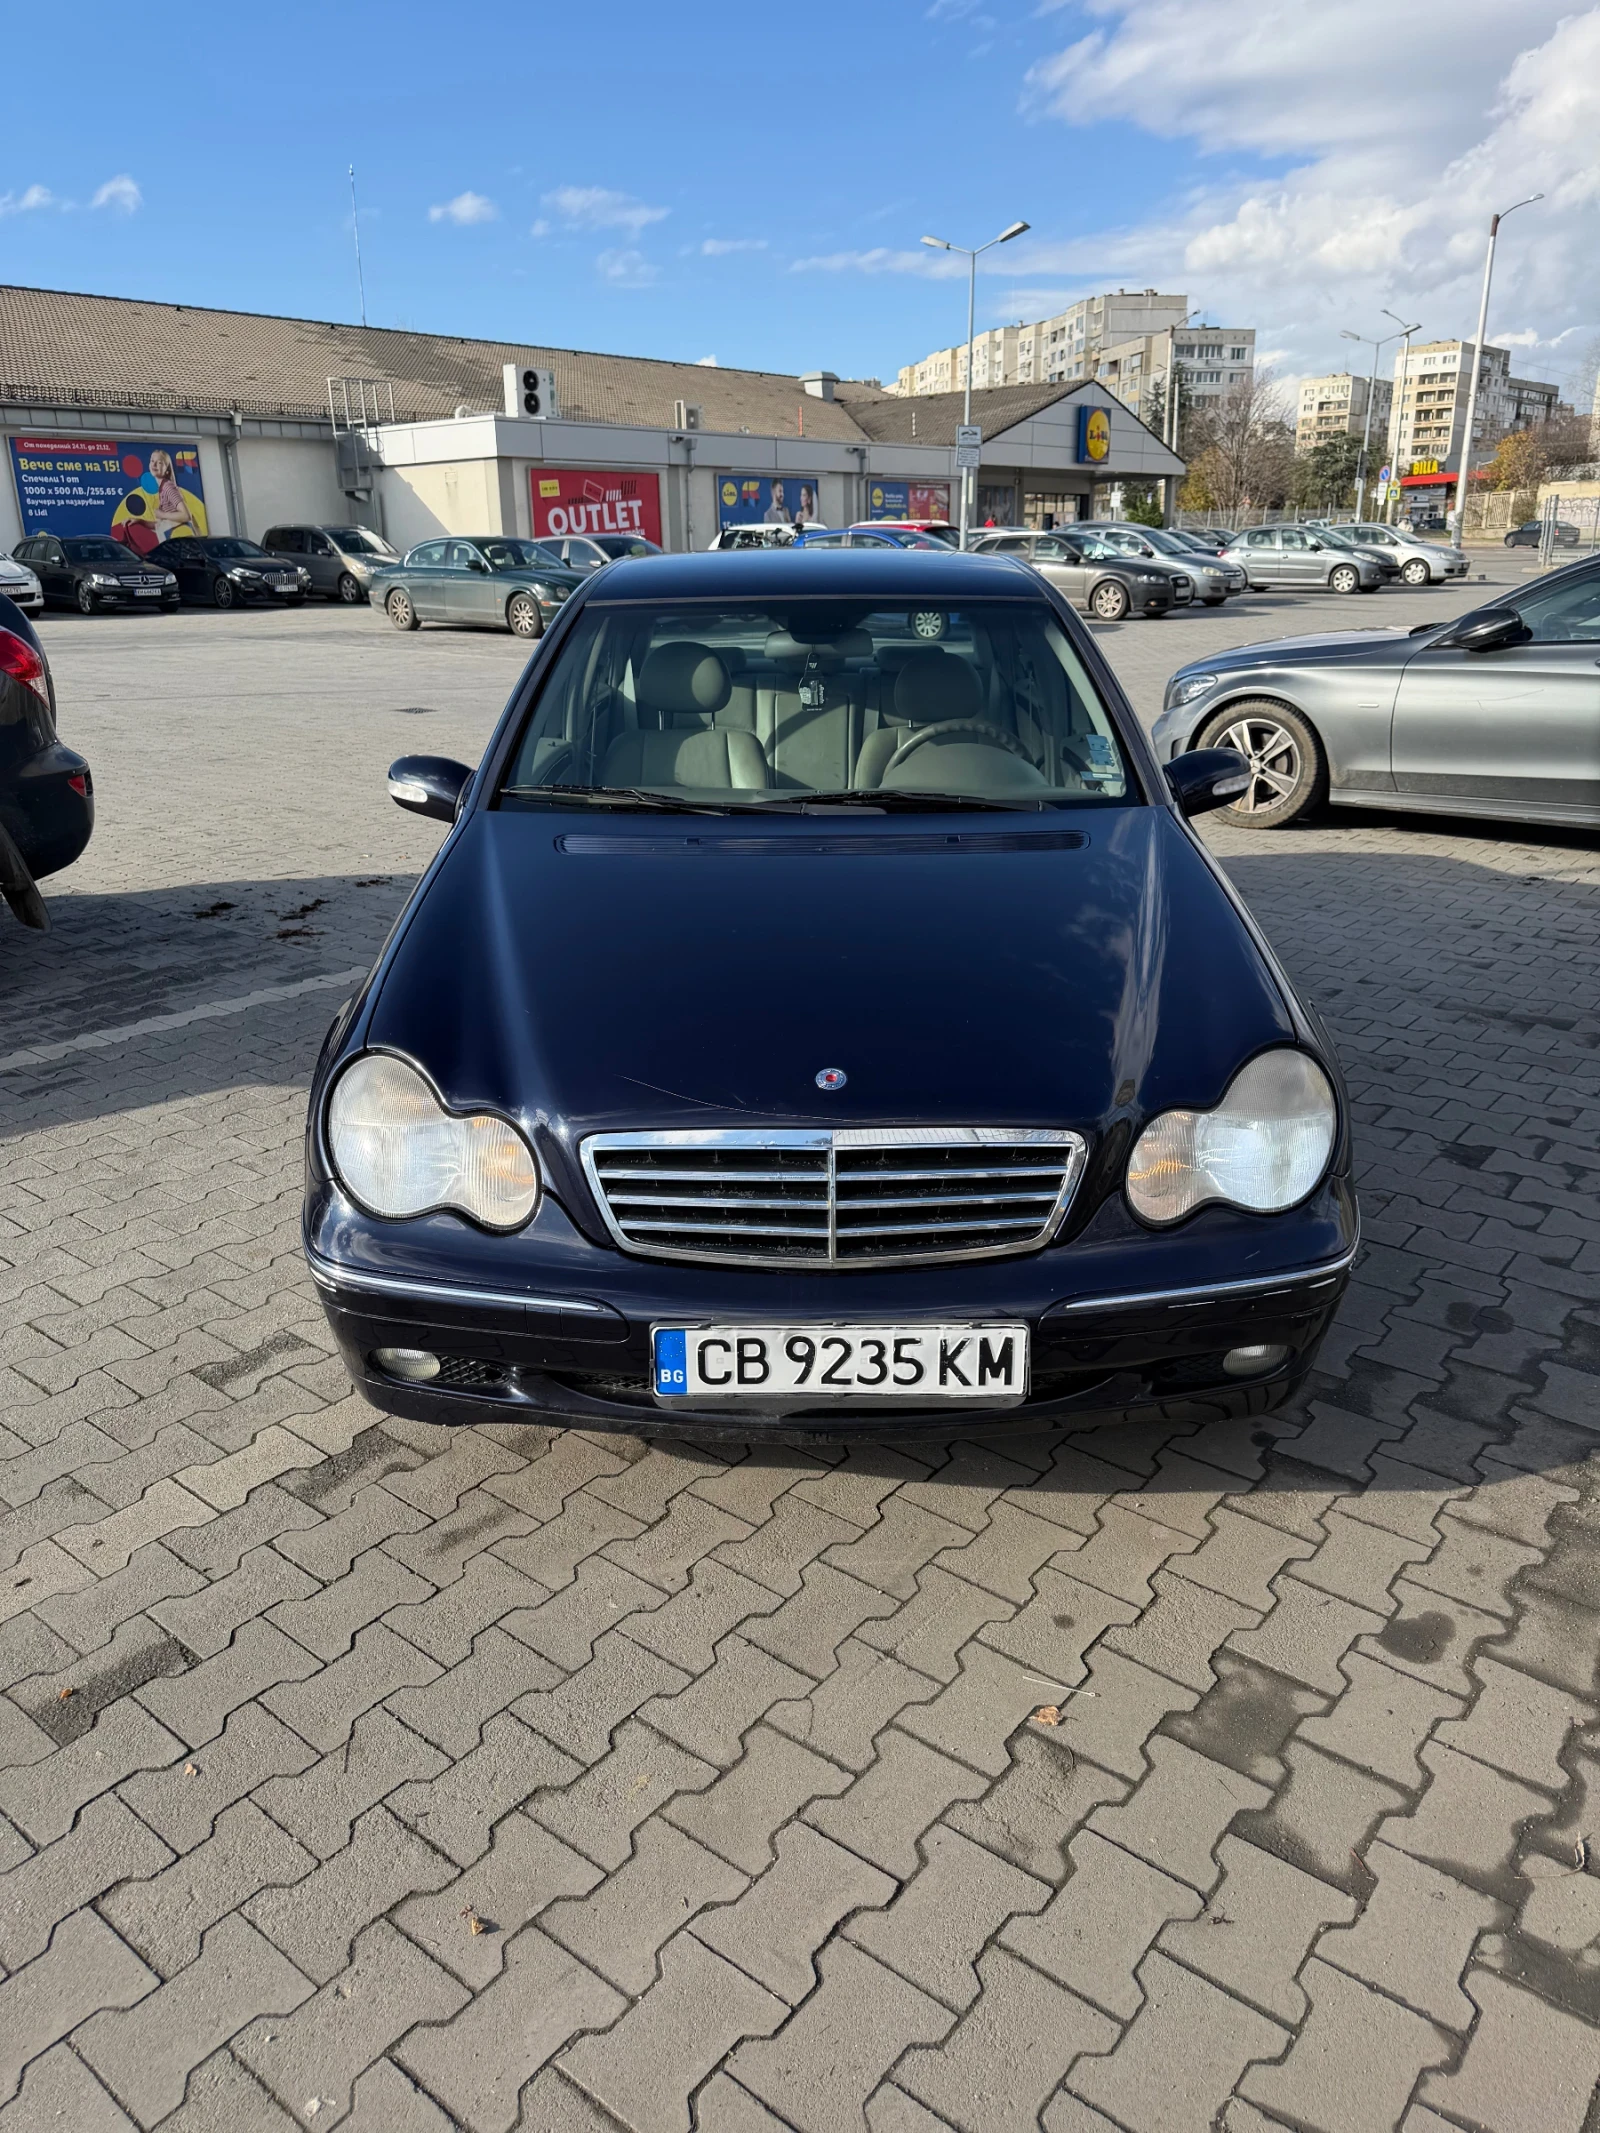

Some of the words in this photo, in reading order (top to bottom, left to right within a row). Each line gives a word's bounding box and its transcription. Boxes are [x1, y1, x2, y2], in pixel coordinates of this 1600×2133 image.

[19, 458, 53, 471] Вече
[56, 462, 82, 472] сме
[85, 463, 101, 472] на
[103, 461, 120, 473] 15!
[1413, 460, 1438, 475] BILLA
[22, 475, 59, 483] Спечели
[60, 475, 65, 483] 1
[24, 487, 46, 495] 1000
[54, 487, 71, 495] 500
[117, 488, 124, 496] €
[26, 498, 56, 506] ваучера
[547, 500, 643, 536] OUTLET
[697, 1337, 770, 1386] CB
[785, 1335, 924, 1386] 9235
[939, 1336, 1014, 1387] KM
[660, 1369, 684, 1384] BG
